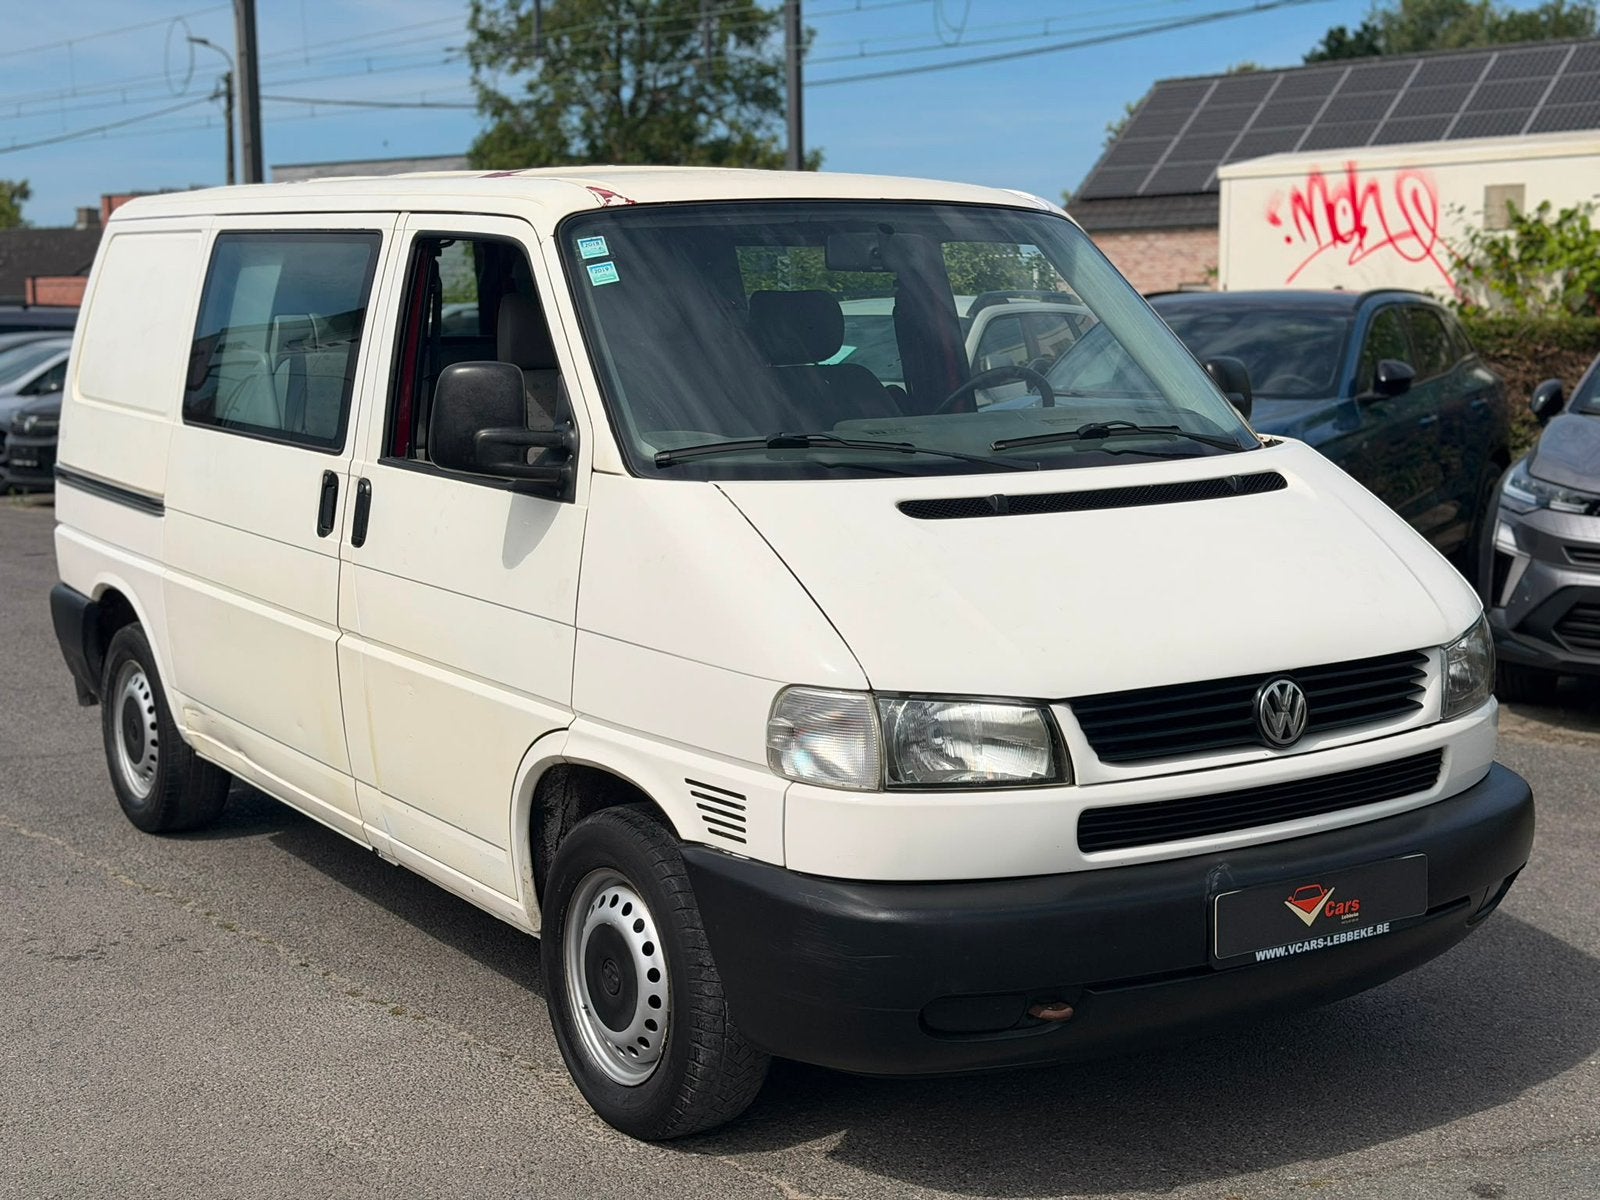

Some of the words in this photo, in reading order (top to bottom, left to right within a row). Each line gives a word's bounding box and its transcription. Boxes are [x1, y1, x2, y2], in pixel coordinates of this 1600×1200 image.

[1260, 680, 1307, 744] VW
[1325, 899, 1360, 918] Cars
[1255, 922, 1390, 962] WWW.VCARS-LEBBEKE.BE
